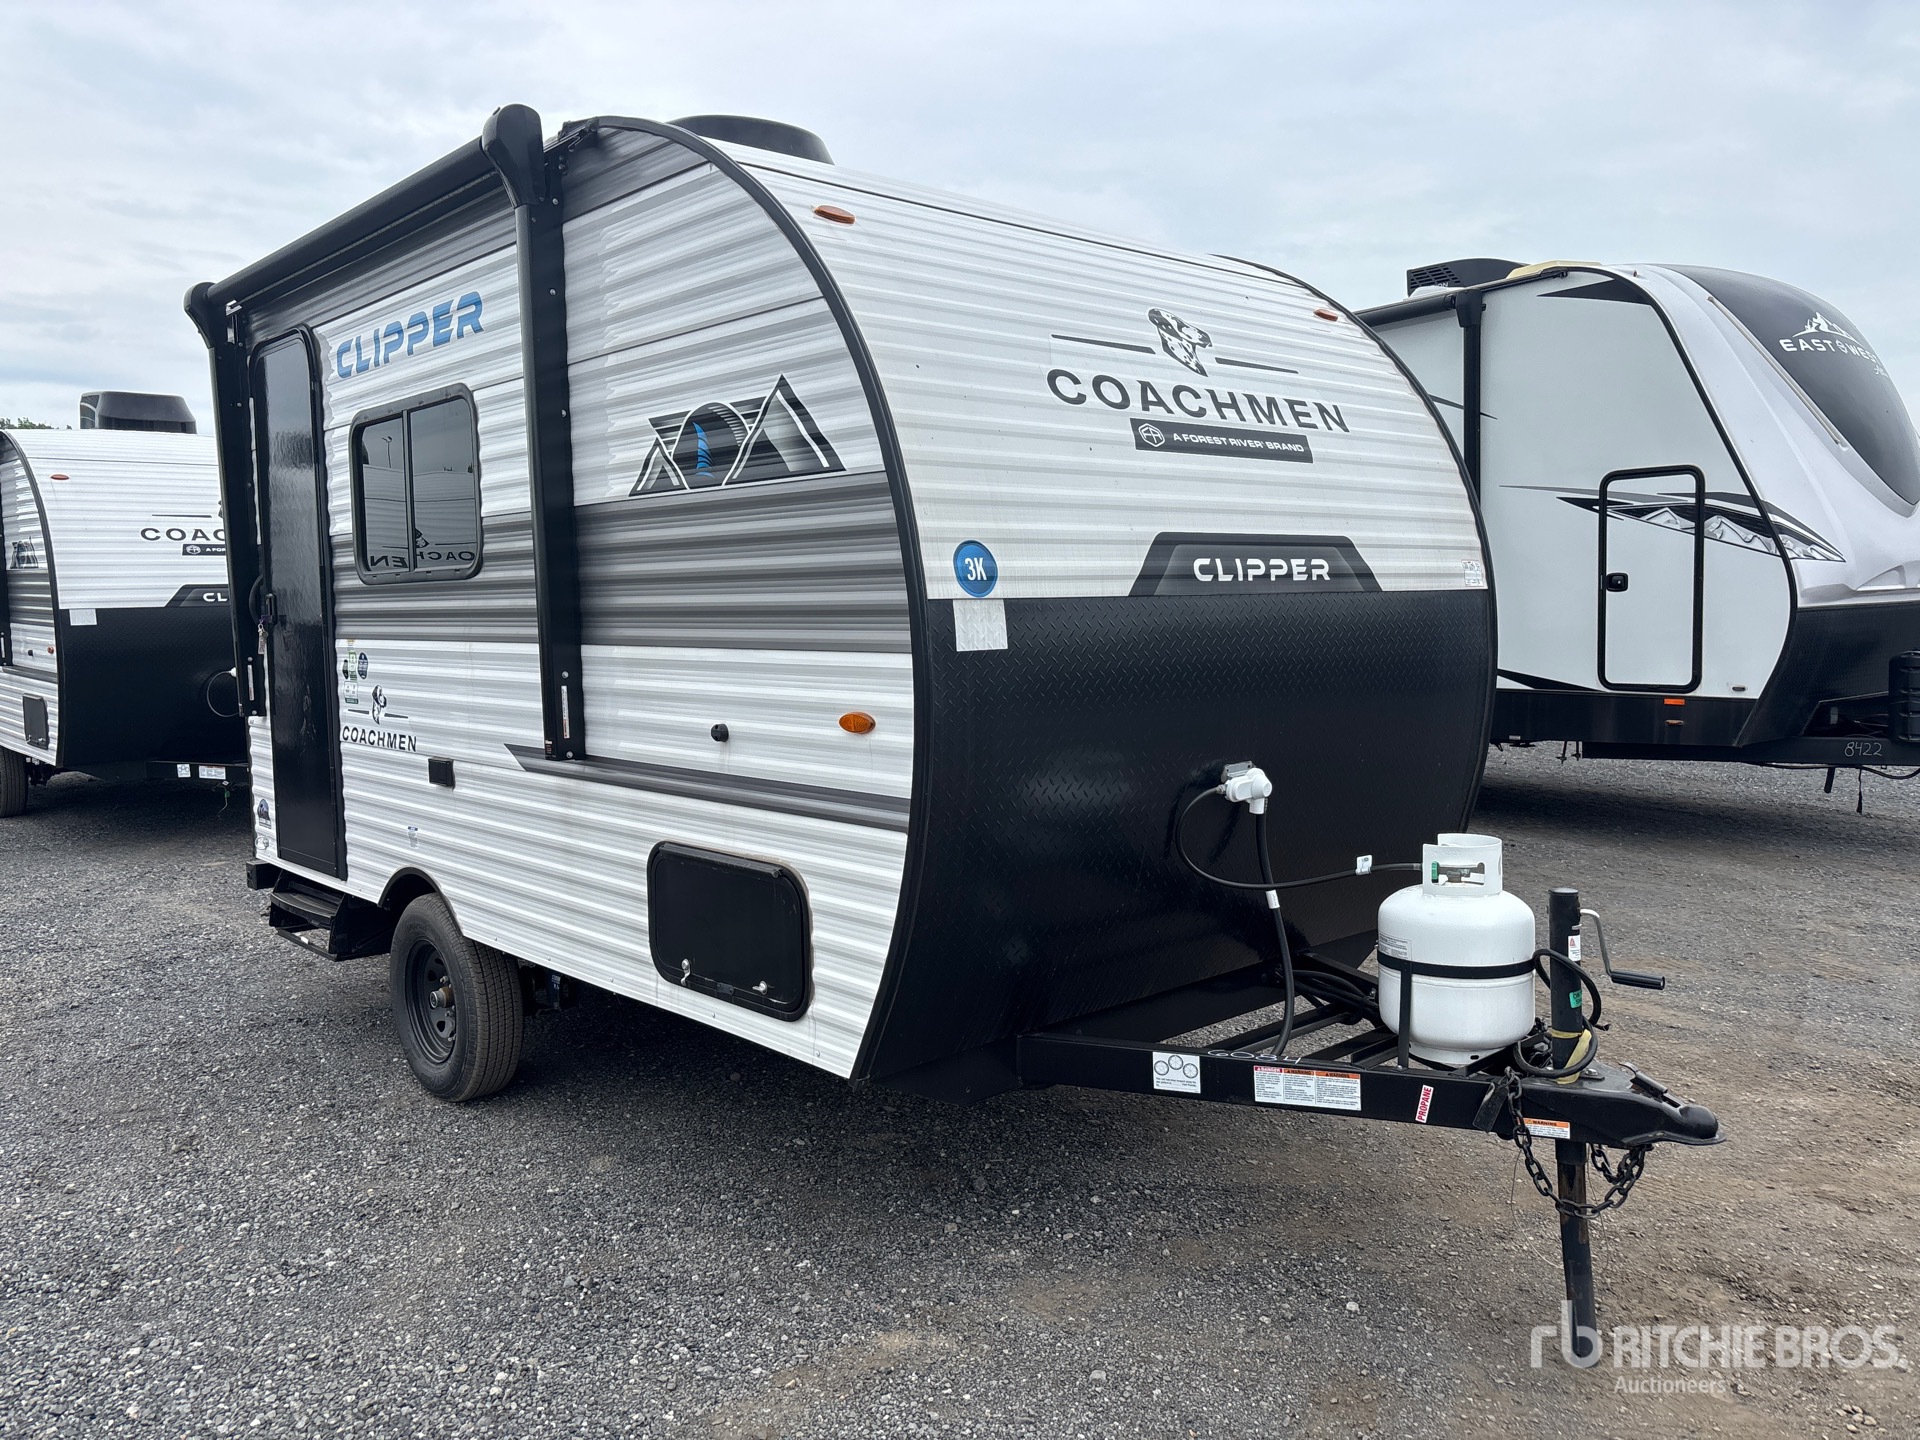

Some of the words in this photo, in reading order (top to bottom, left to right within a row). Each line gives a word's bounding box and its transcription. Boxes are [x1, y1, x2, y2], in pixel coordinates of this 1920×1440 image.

[336, 291, 484, 378] CLIPPER
[1779, 338, 1836, 352] EAST
[1047, 369, 1350, 433] COACHMEN
[1173, 433, 1182, 441] A
[1182, 434, 1228, 446] FOREST
[1265, 441, 1304, 452] BRAND
[965, 557, 987, 581] 3K
[1193, 558, 1330, 581] CLIPPER
[342, 725, 416, 752] COACHMEN
[1844, 741, 1882, 757] 8422
[1417, 1086, 1432, 1122] PROPANE
